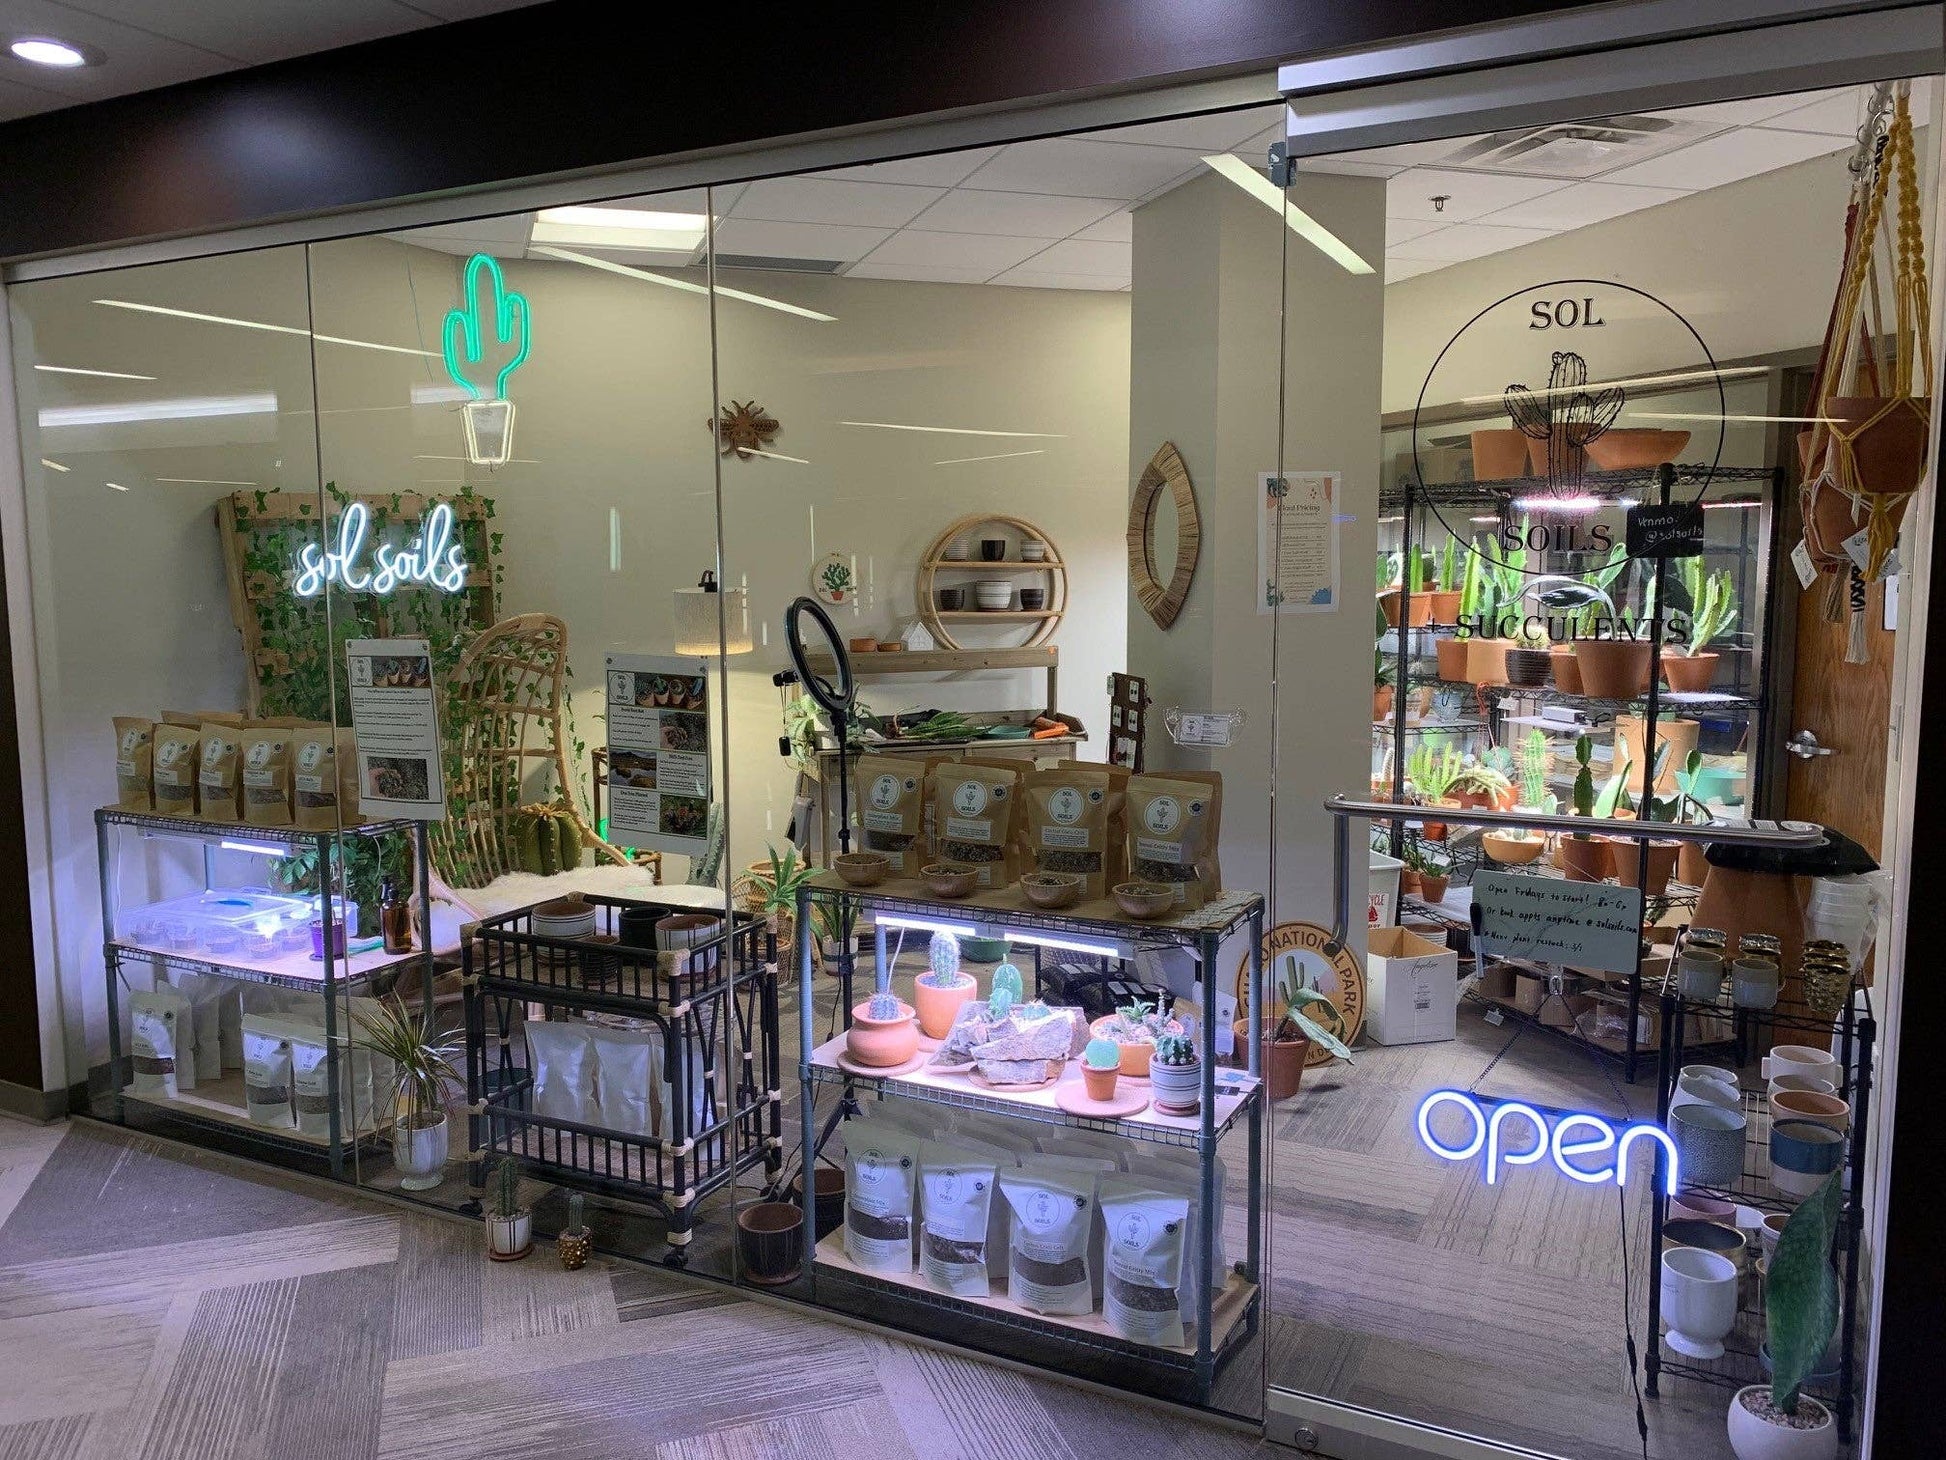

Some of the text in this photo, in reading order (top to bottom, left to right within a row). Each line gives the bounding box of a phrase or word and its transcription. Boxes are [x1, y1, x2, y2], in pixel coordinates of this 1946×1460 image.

[1529, 297, 1604, 330] SOL
[293, 502, 468, 598] sol soils
[1503, 524, 1613, 552] SOILS
[1455, 614, 1687, 645] SUCCULENTS
[1487, 884, 1508, 896] Open
[1515, 887, 1546, 900] Fridays
[1550, 892, 1560, 901] to
[1486, 905, 1496, 915] Or
[1500, 907, 1514, 918] book
[1518, 913, 1541, 923] appts
[1546, 914, 1581, 926] anytime
[1273, 930, 1357, 1016] NATIONL PARK
[1416, 1089, 1680, 1197] open
